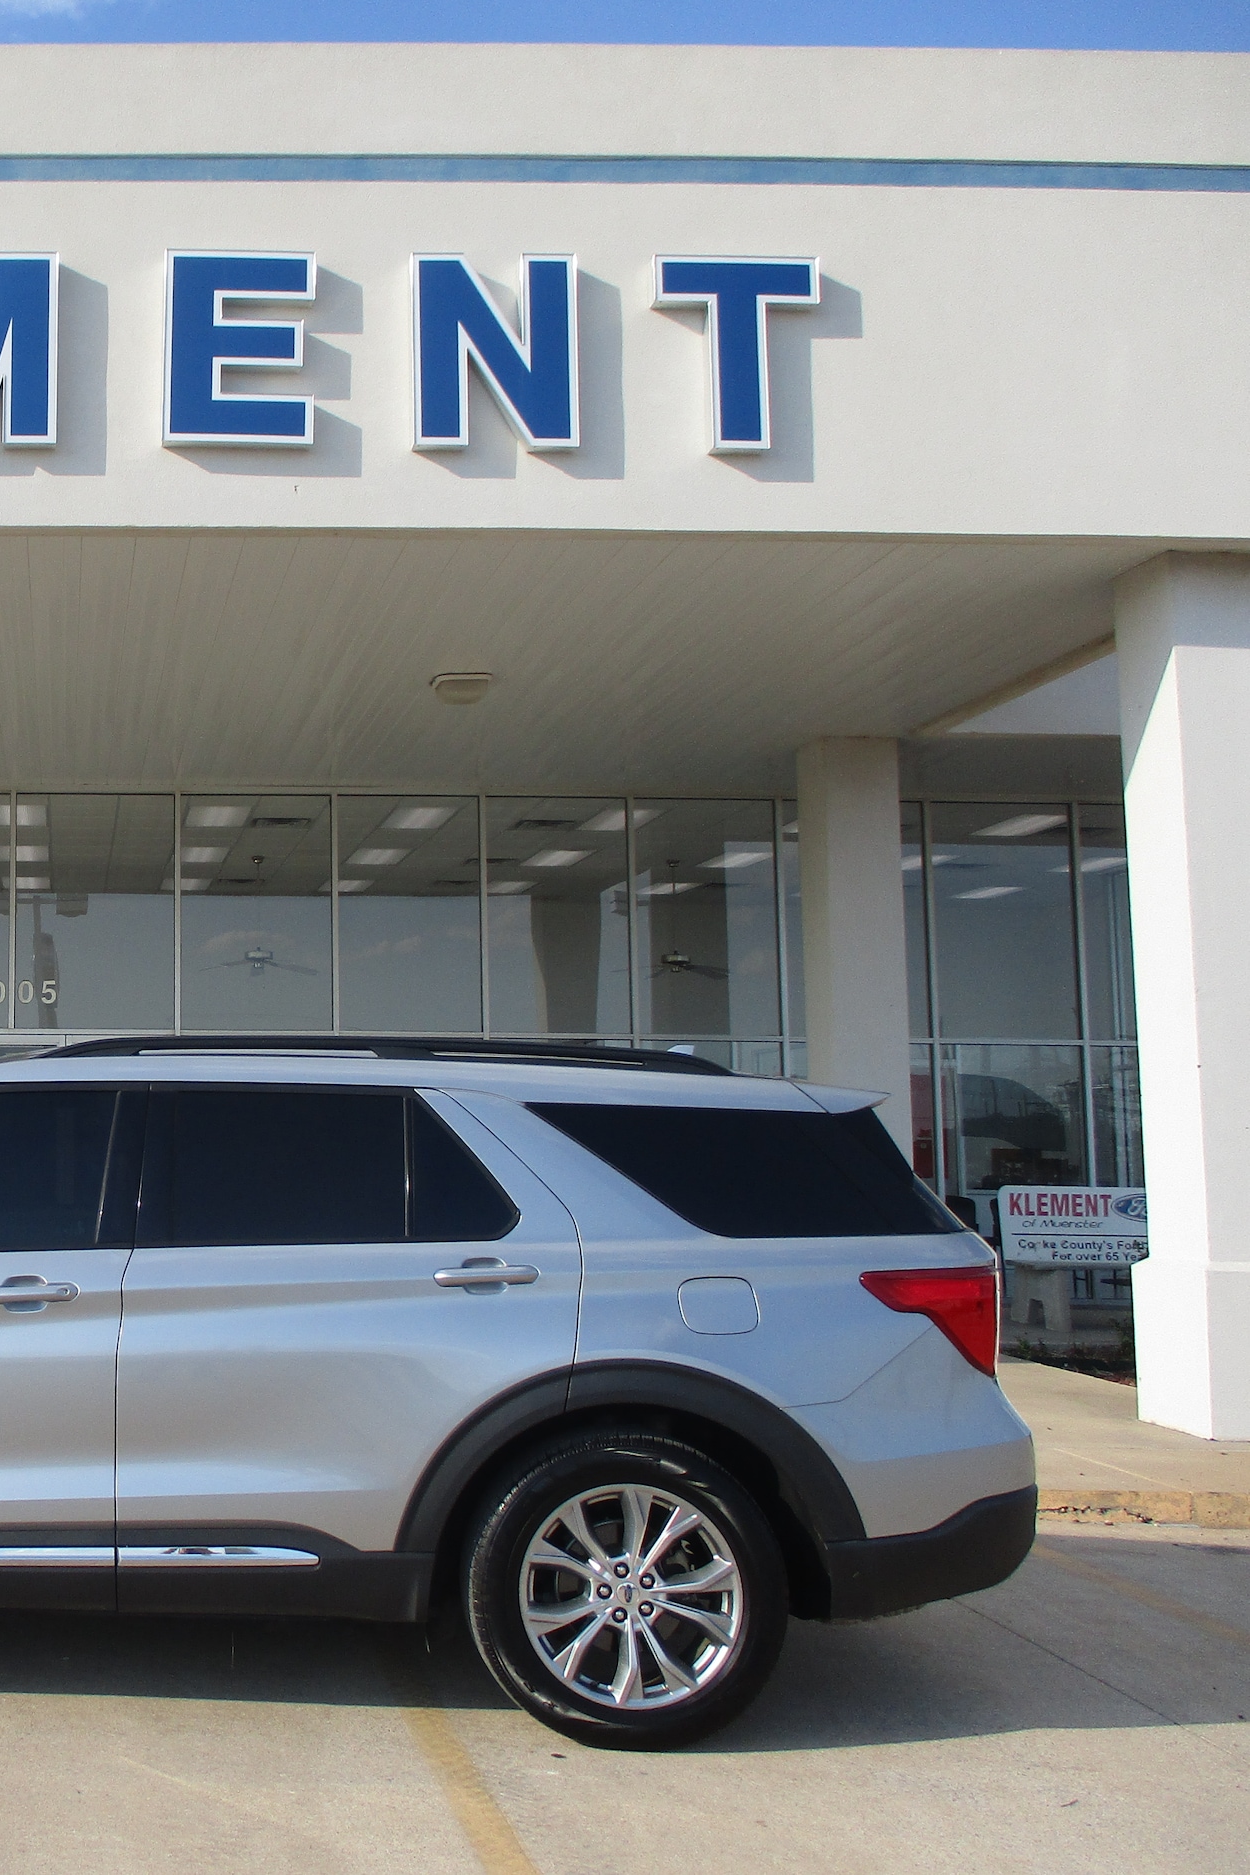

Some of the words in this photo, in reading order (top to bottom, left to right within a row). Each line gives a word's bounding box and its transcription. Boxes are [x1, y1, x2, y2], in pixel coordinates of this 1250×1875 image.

[1009, 1193, 1112, 1217] KLEMENT
[1040, 1219, 1103, 1229] Muenster
[1018, 1239, 1057, 1249] Coke
[1060, 1239, 1113, 1252] County's
[1052, 1250, 1071, 1260] For
[1076, 1252, 1101, 1261] over
[1105, 1251, 1119, 1261] 65
